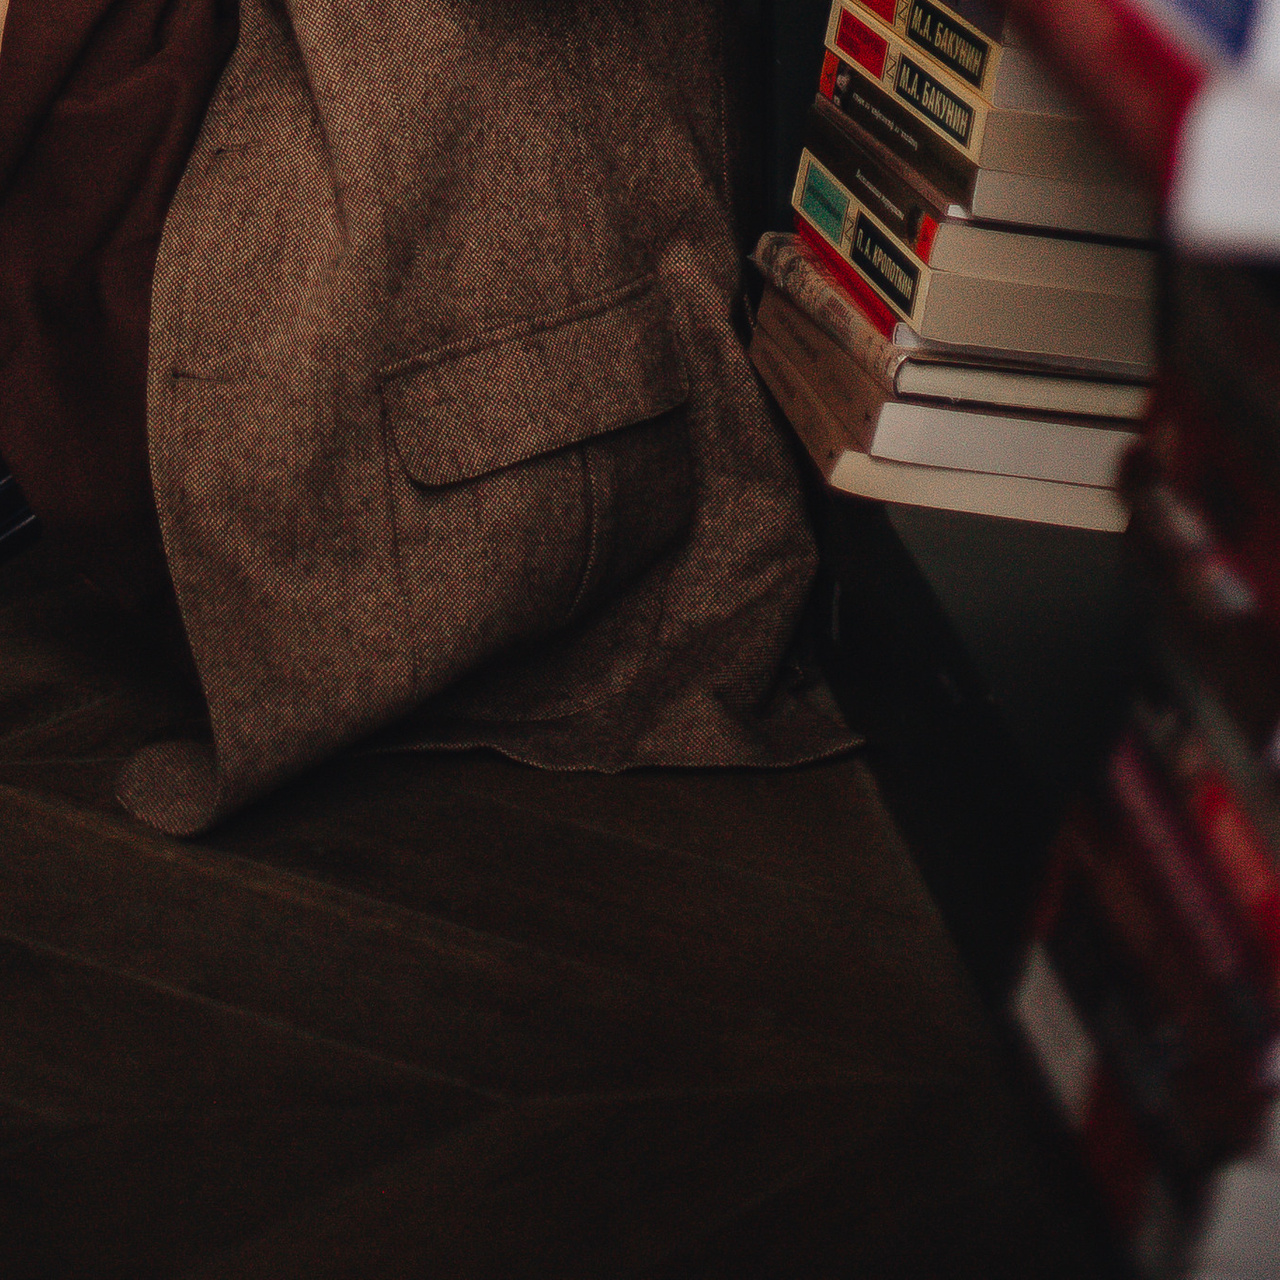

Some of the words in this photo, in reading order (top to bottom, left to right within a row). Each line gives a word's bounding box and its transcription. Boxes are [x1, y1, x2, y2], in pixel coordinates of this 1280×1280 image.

[933, 21, 983, 77] БАКУНИН
[920, 81, 970, 138] БАКУНИН
[870, 242, 914, 304] КРОПОТКИН
